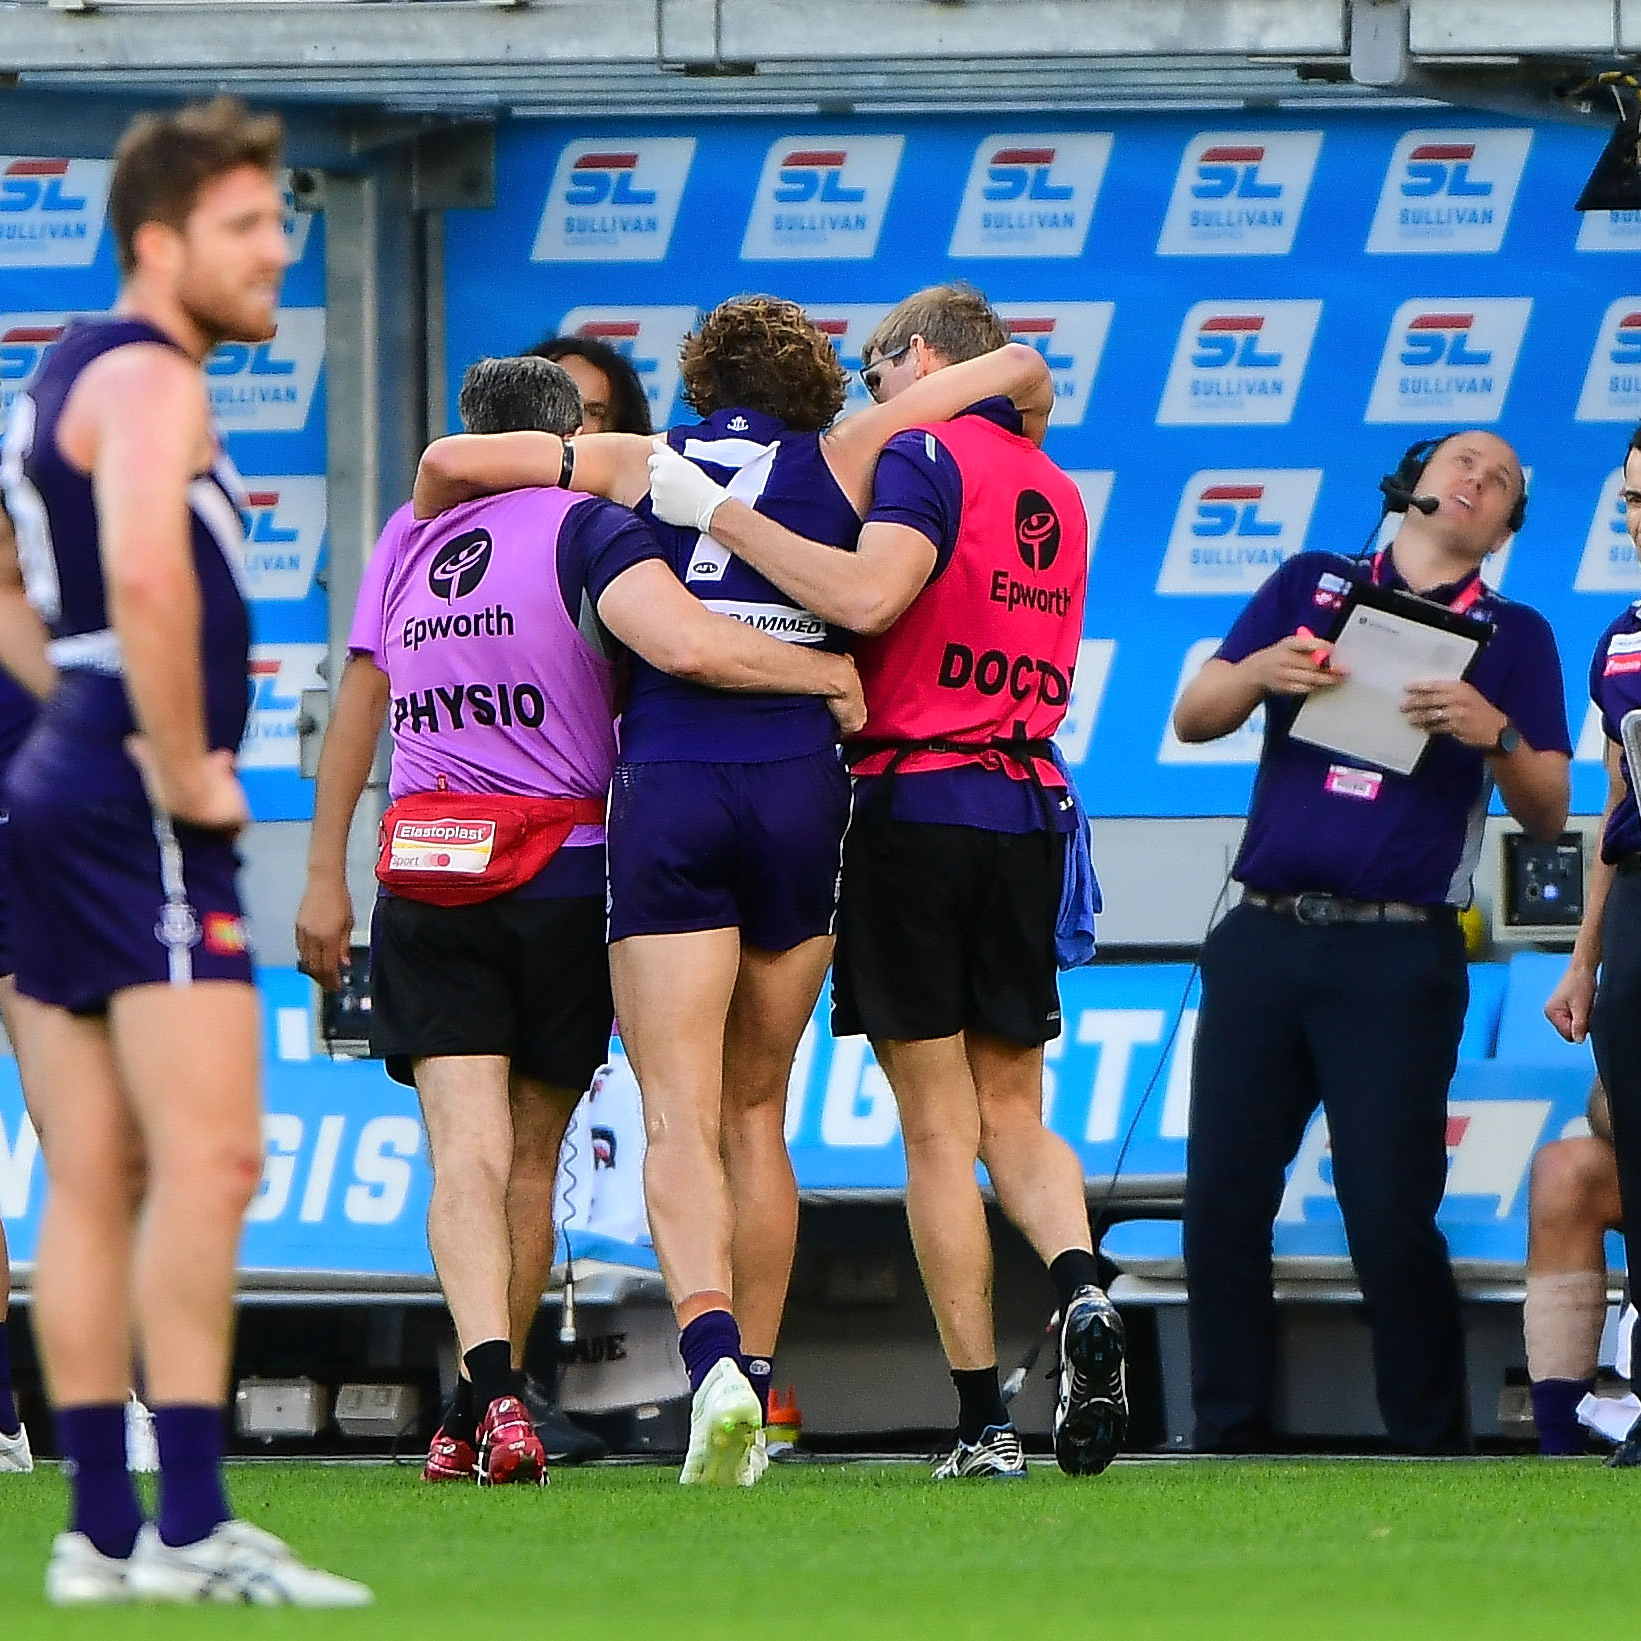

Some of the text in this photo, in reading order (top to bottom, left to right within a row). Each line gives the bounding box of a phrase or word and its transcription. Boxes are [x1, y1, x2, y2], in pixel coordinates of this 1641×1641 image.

[772, 214, 865, 233] SULLIVAN
[980, 212, 1073, 231] SULLIVAN
[1189, 209, 1282, 228] SULLIVAN
[1399, 207, 1492, 226] SULLIVAN
[563, 217, 656, 236] SULLIVAN
[1189, 379, 1282, 398] SULLIVAN
[1399, 377, 1492, 396] SULLIVAN
[1189, 548, 1282, 567] SULLIVAN
[693, 561, 719, 575] AFL
[990, 569, 1072, 618] Epworth
[402, 604, 516, 652] Epworth
[938, 641, 1076, 708] DOCTO
[394, 683, 546, 735] PHYSIO
[400, 825, 486, 844] Elastoplast
[390, 853, 421, 869] Sport
